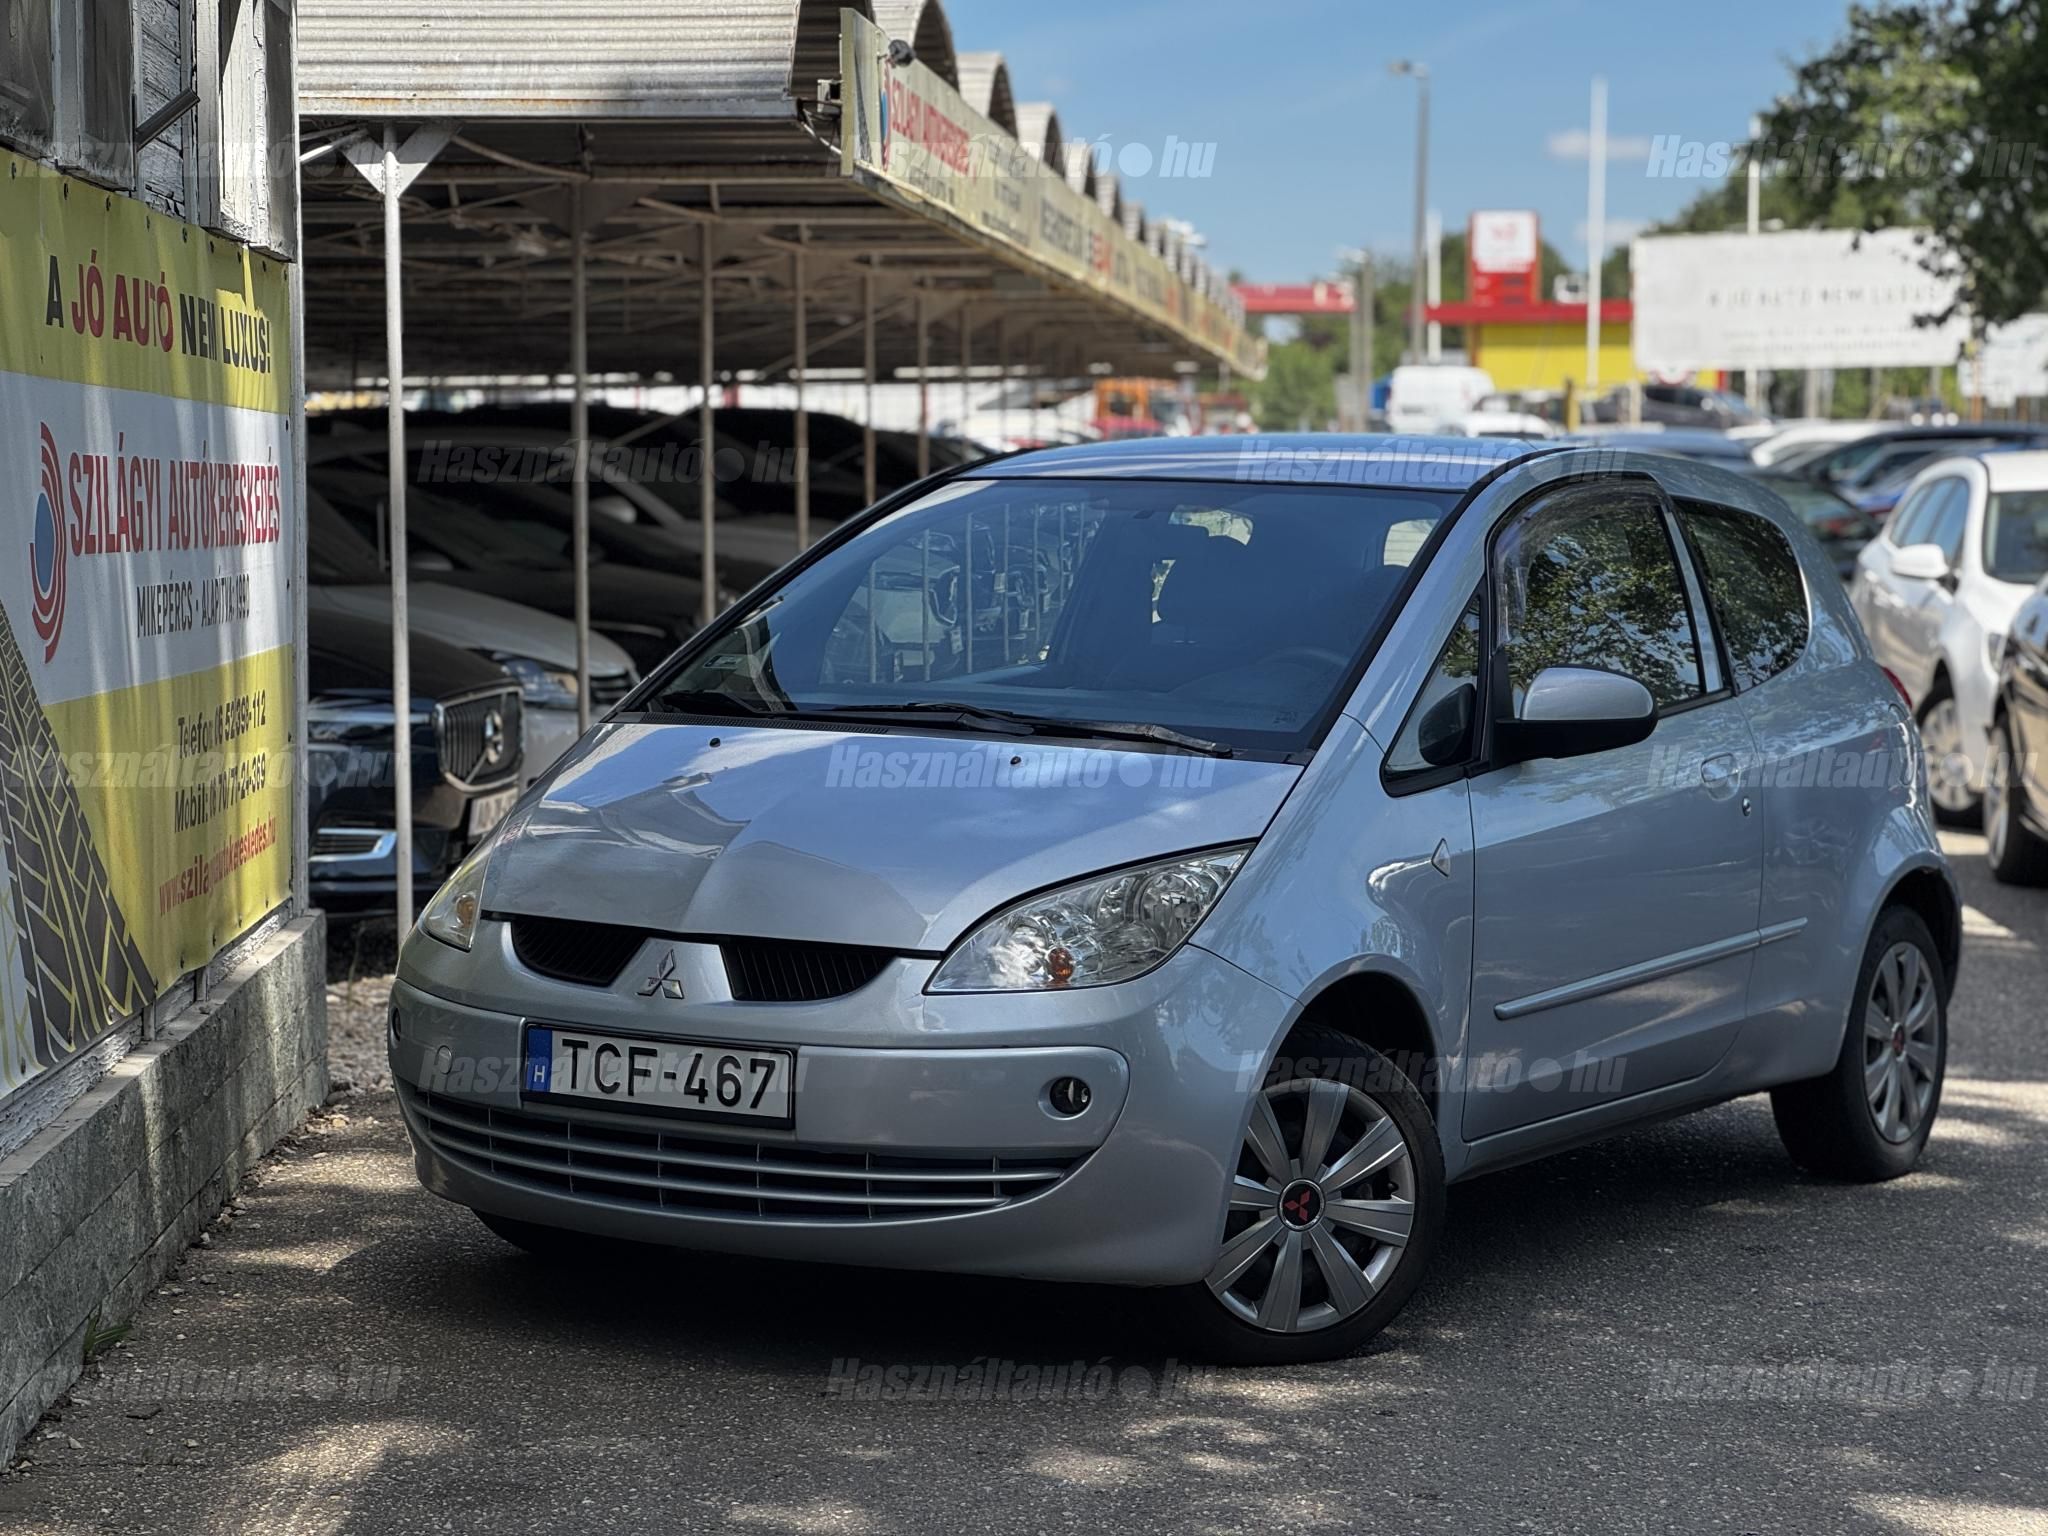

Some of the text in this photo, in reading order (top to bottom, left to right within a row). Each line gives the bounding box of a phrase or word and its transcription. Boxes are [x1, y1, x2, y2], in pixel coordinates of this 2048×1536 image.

[46, 249, 271, 374] A JÓ AUTÓ NEM LUXUS!
[69, 432, 281, 557] SZILÁGYI AUTÓKERESKEDÉS
[136, 568, 193, 639] MIKEPÉRCS
[174, 781, 209, 834] Mobil:
[533, 1065, 546, 1084] H
[562, 1038, 777, 1110] TCF-467
